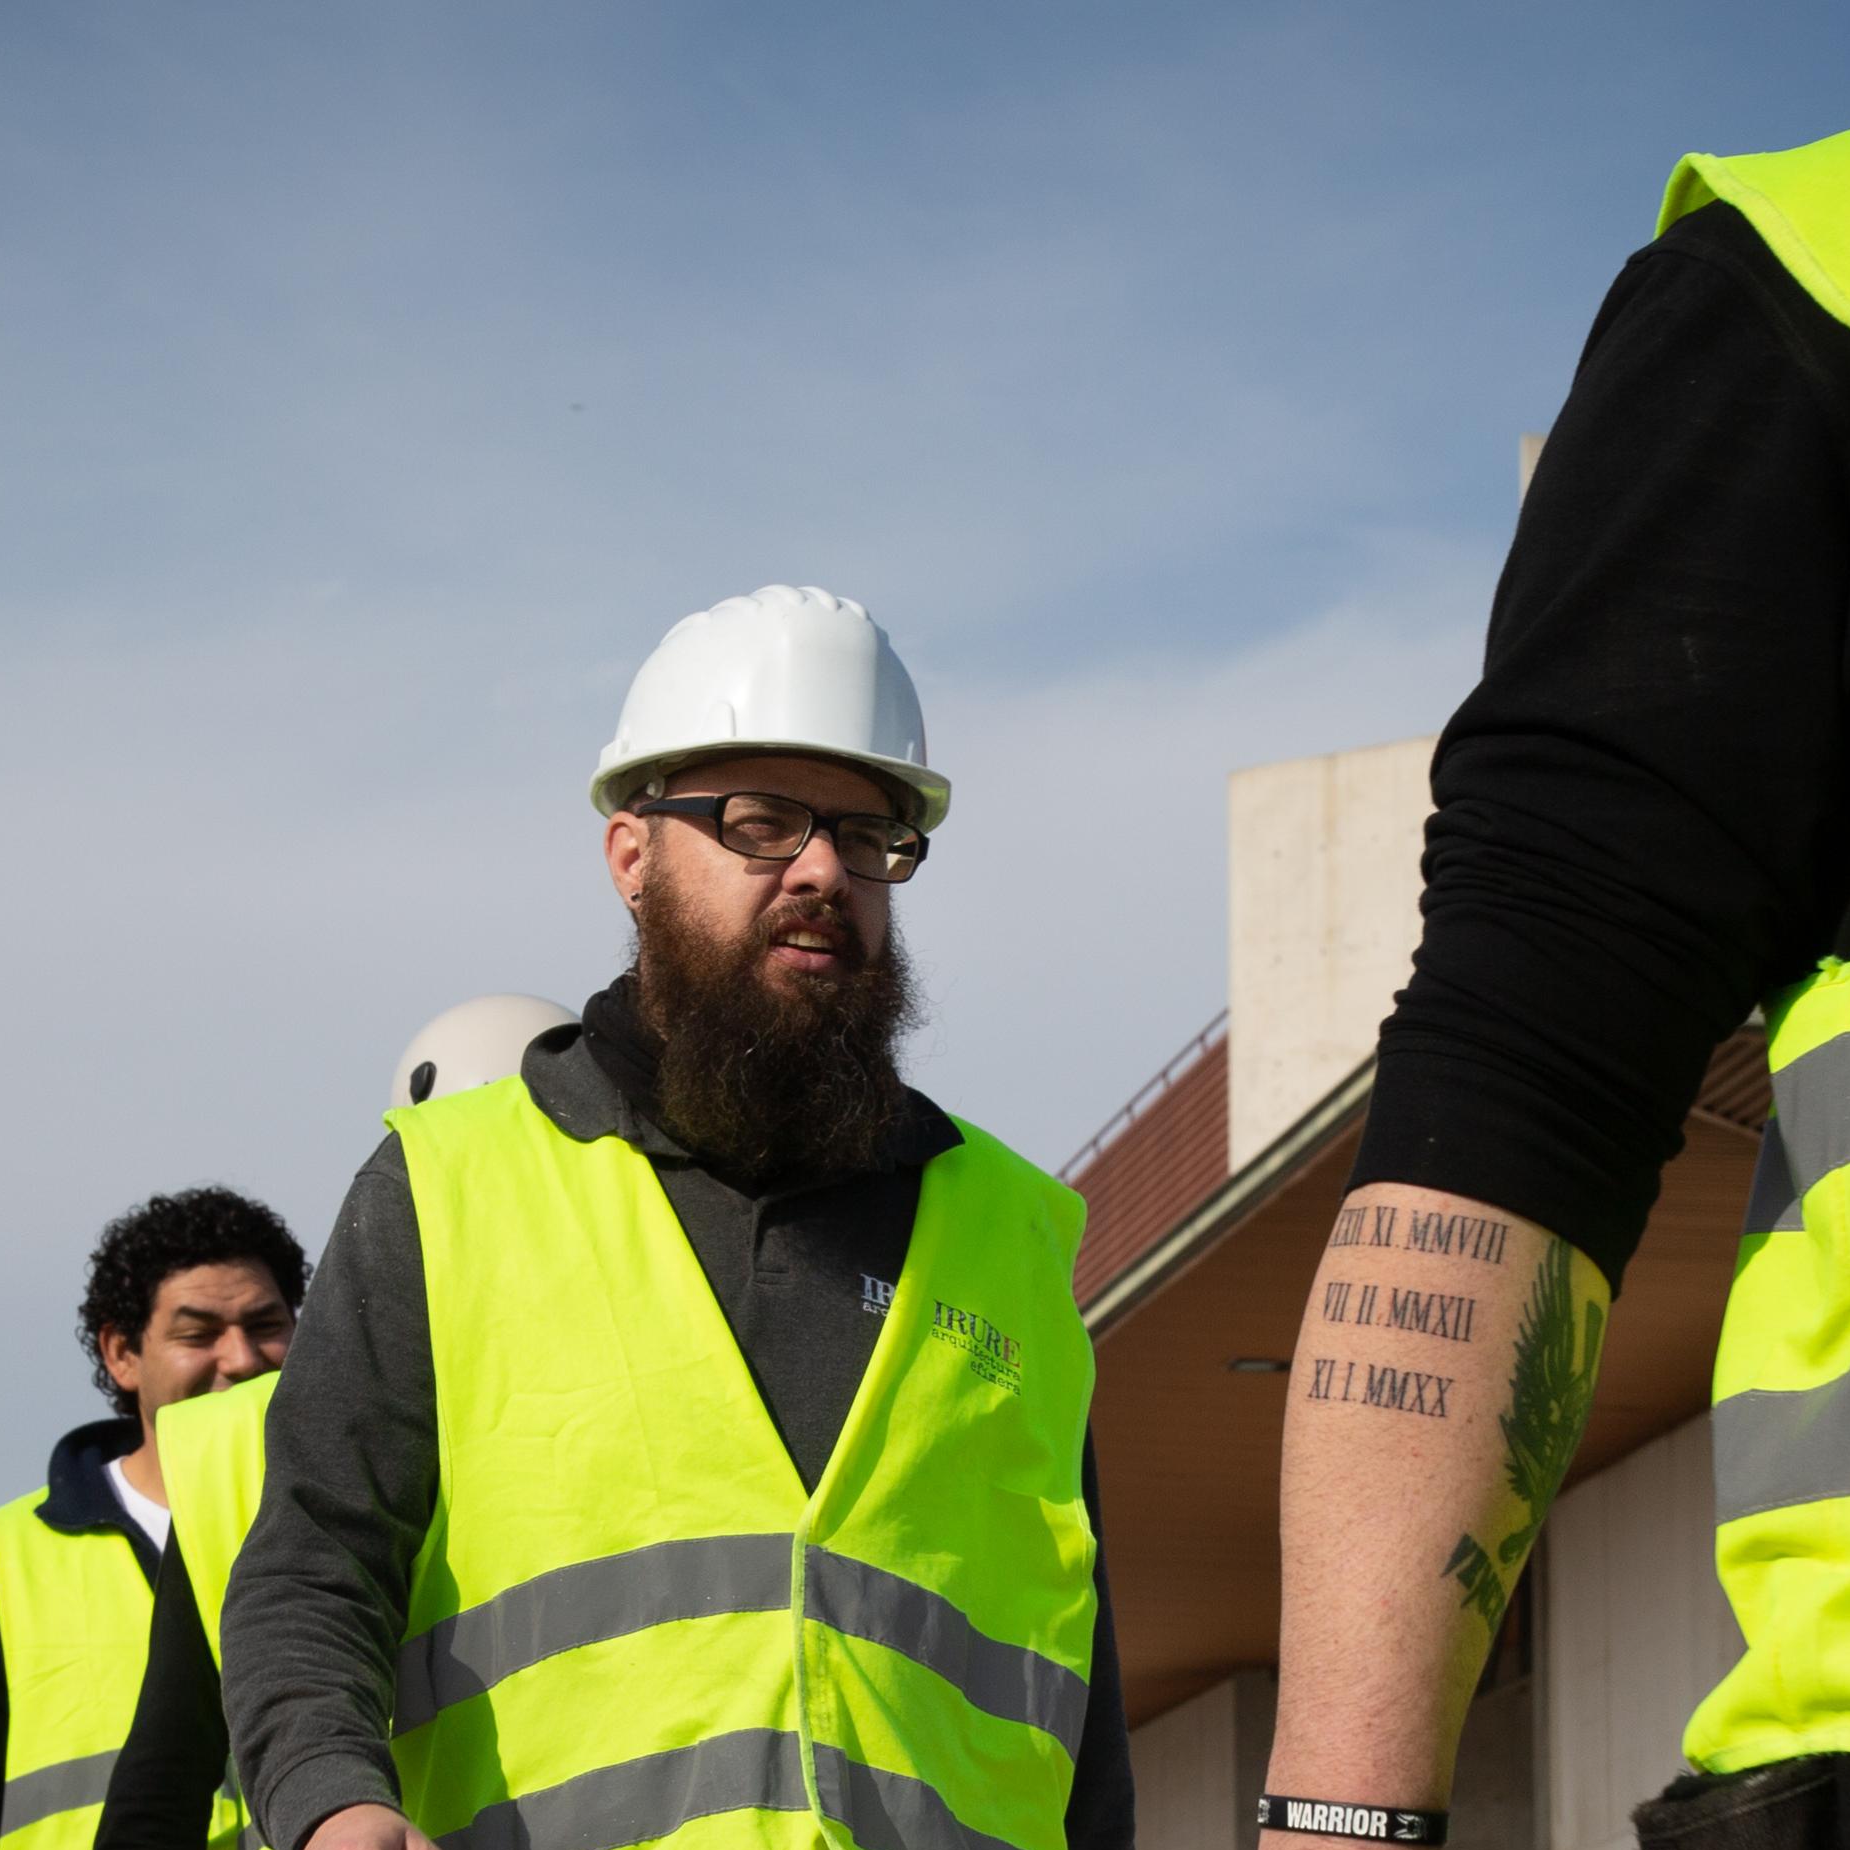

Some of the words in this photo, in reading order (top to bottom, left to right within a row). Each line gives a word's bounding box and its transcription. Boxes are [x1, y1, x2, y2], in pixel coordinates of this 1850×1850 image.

[1403, 1210, 1509, 1265] MMVIII
[933, 1299, 1021, 1368] IRURE
[1385, 1287, 1477, 1342] MMXII
[1361, 1364, 1455, 1418] MMXX
[1286, 1801, 1388, 1838] WARRIOR
